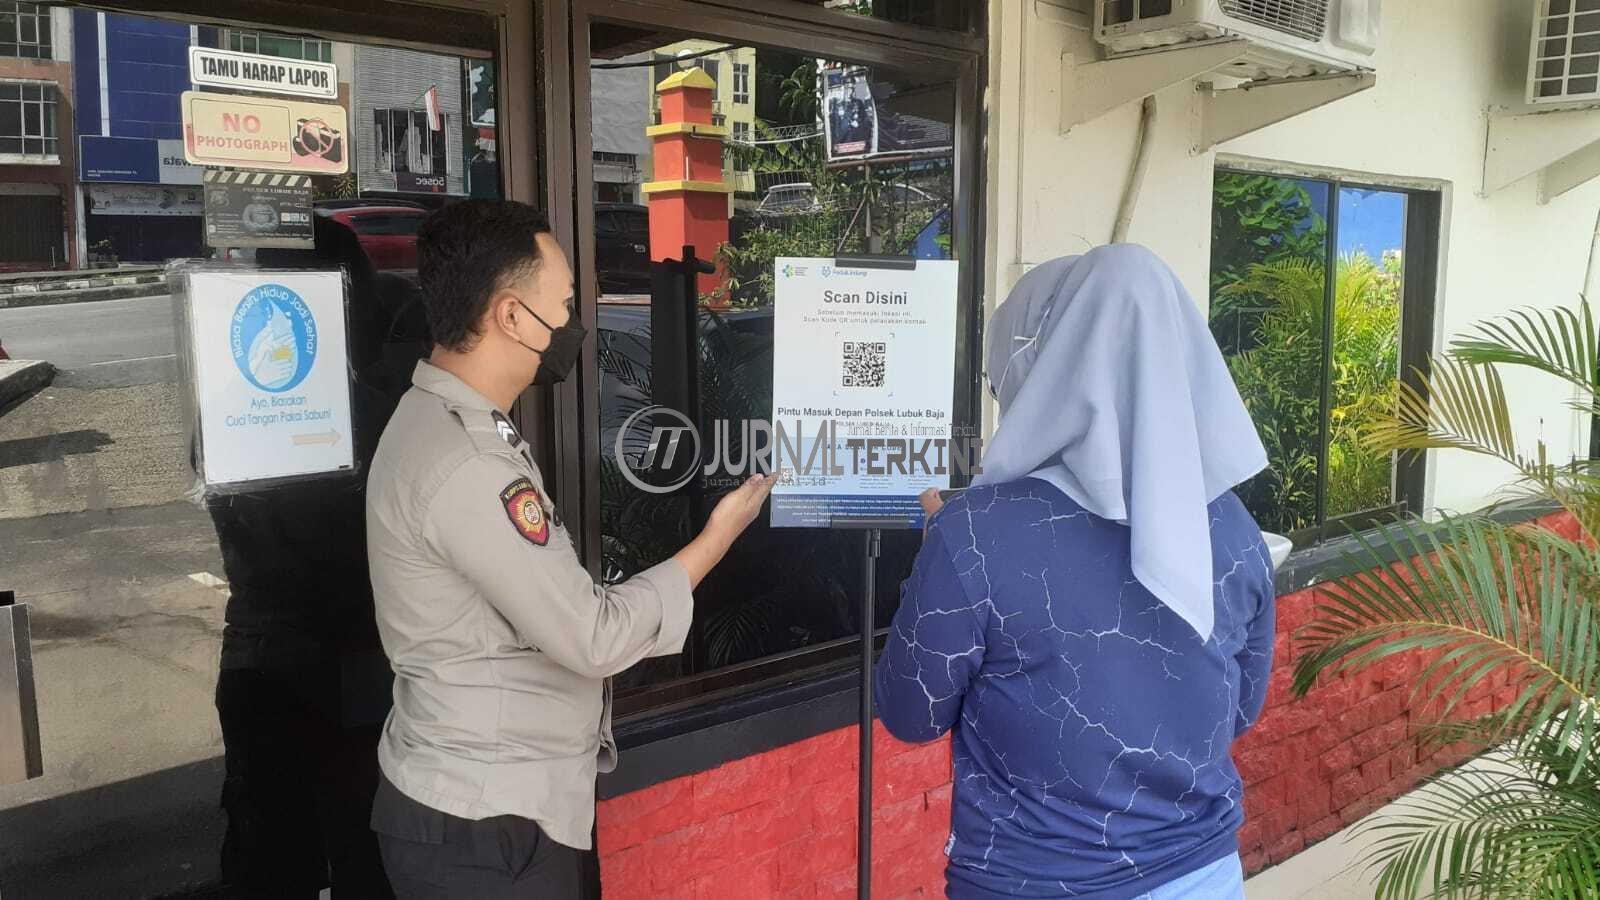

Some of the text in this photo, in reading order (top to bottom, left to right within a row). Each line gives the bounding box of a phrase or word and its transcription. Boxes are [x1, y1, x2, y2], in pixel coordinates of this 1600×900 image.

[200, 56, 329, 88] TAMU HARAP LAPOR
[222, 112, 261, 134] NO
[196, 135, 288, 152] PHOTOGRAPH
[824, 290, 907, 305] Scan Disini
[232, 324, 244, 358] Biasa
[260, 287, 289, 300] Hidup
[288, 296, 310, 319] Jadi
[304, 318, 315, 355] Sehat
[225, 415, 246, 426] Cuci
[248, 413, 279, 426] Tangan
[280, 411, 302, 422] Pakai
[777, 407, 945, 419] Pintu Masuk Depan Polsek Lubuk Baja
